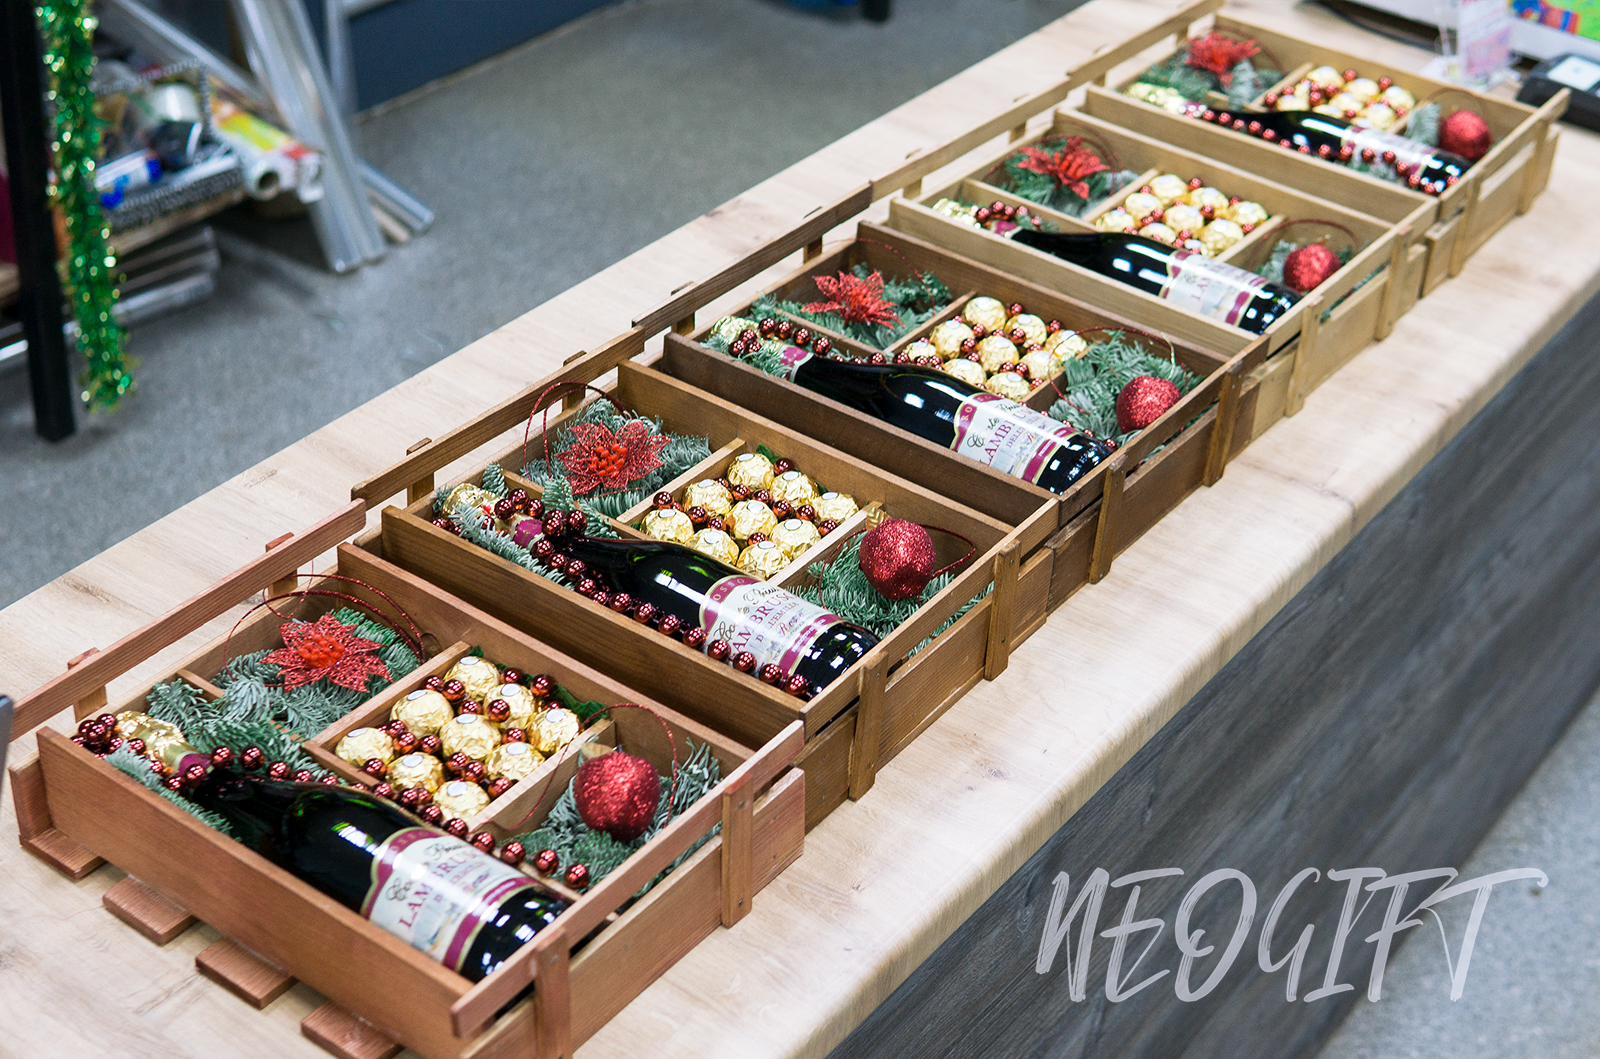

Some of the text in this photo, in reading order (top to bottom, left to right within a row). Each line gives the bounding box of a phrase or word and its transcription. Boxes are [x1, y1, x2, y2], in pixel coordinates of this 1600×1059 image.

[967, 416, 999, 447] Crte
[711, 577, 745, 601] OSSO
[712, 606, 750, 642] Cote
